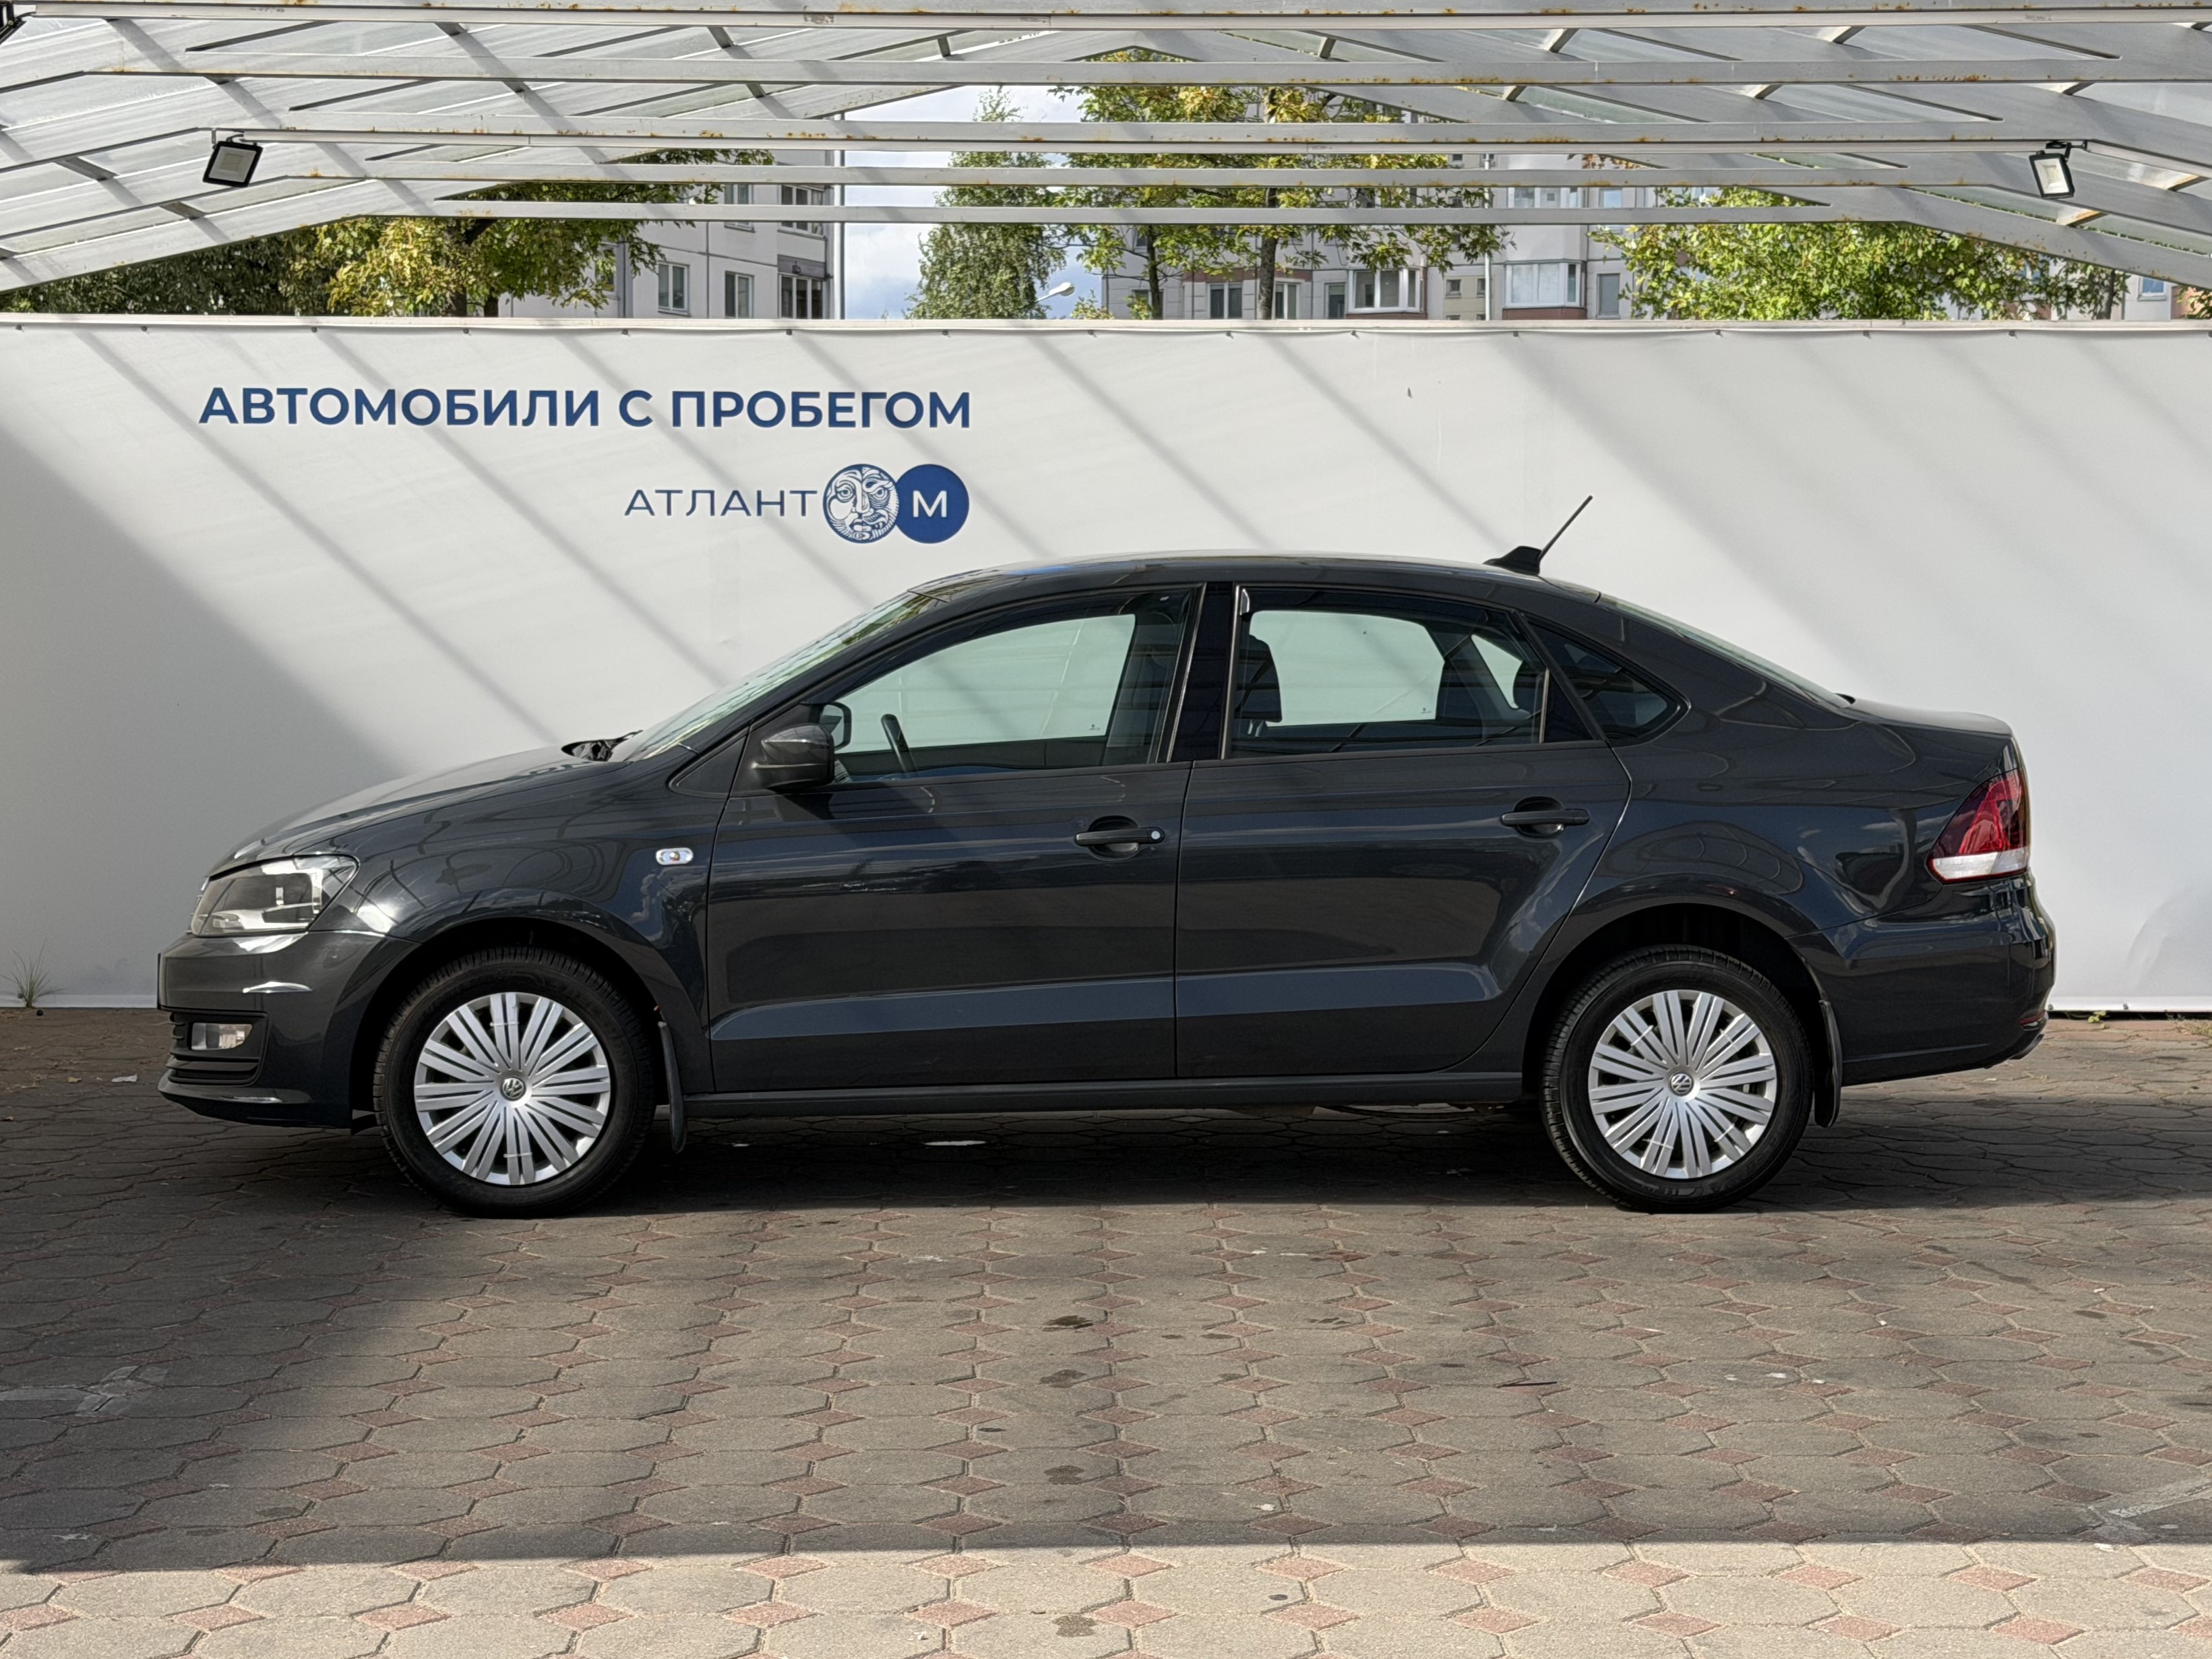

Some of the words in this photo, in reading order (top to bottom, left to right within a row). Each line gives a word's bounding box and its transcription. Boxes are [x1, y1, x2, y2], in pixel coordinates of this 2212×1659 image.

[199, 386, 598, 427] АВТОМОБИЛИ
[618, 389, 652, 427] С
[673, 390, 970, 428] ПРОБЕГОМ
[624, 489, 818, 516] АТЛАНТ
[913, 490, 947, 518] М
